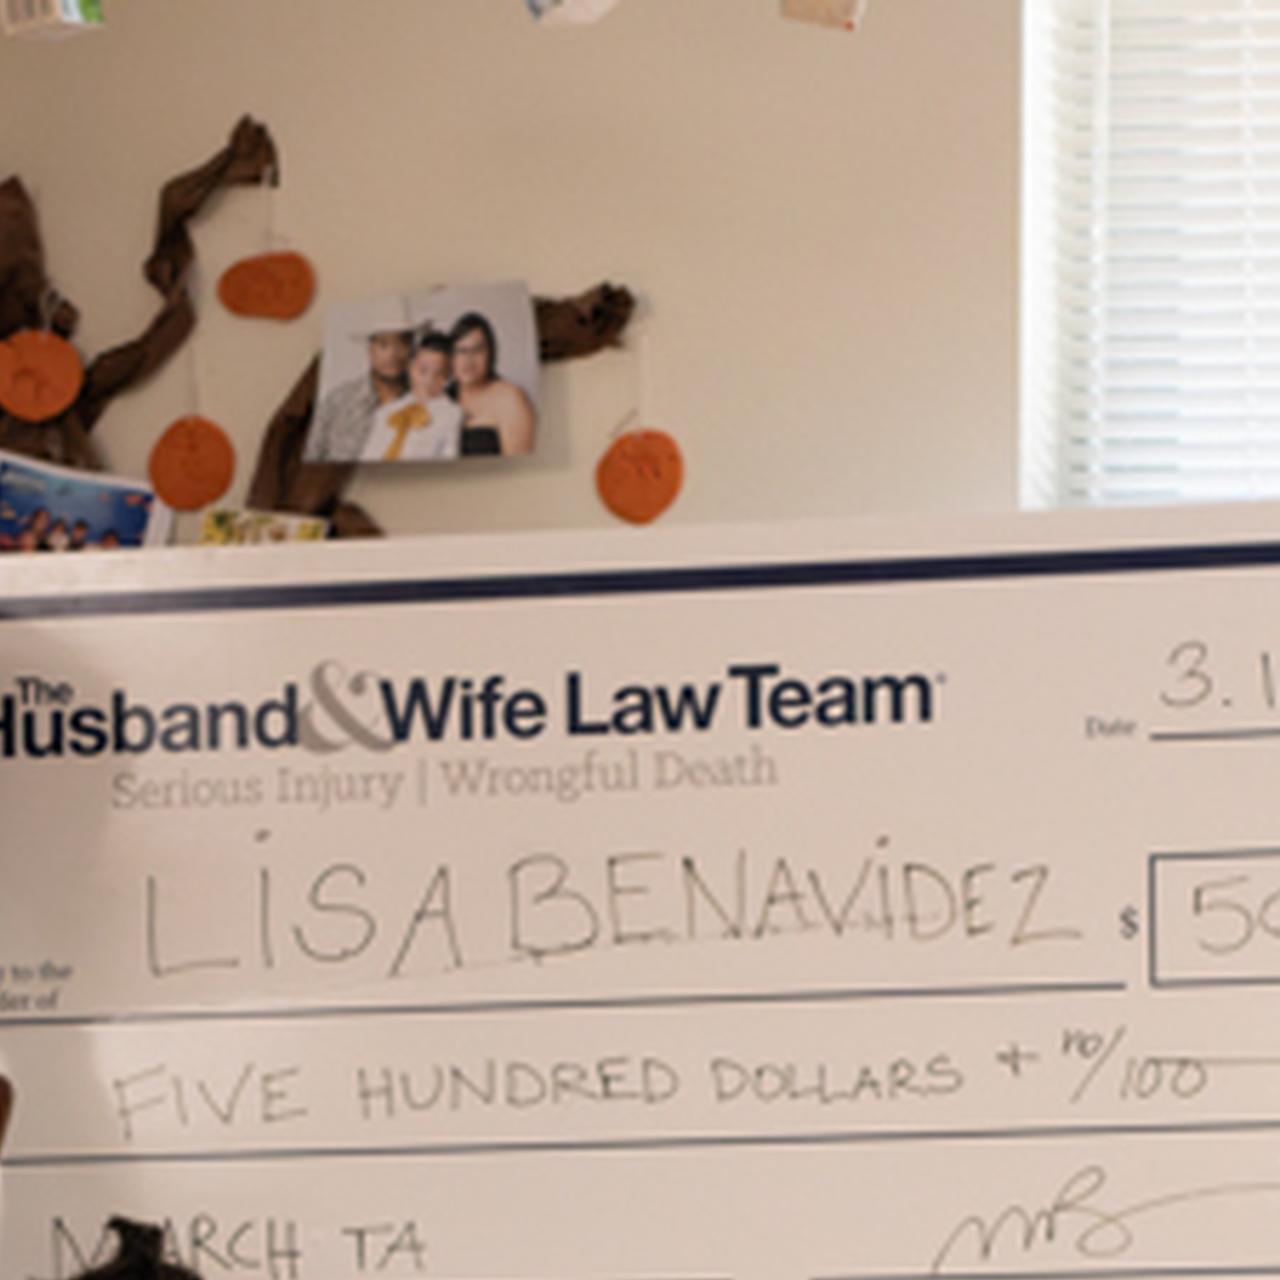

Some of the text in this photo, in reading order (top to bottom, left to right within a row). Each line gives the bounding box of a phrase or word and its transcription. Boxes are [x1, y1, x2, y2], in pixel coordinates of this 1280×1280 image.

[16, 676, 74, 705] The
[300, 659, 398, 754] &
[380, 673, 547, 742] Wife
[566, 670, 722, 737] Law
[728, 664, 933, 729] Team
[1085, 716, 1137, 739] Date
[111, 745, 779, 813] Serious Injury Wrongful Death
[1120, 904, 1140, 940] $
[112, 1062, 309, 1141] FIVE
[356, 1057, 680, 1121] HUNDRED
[709, 1054, 965, 1103] DOLLARS
[341, 1219, 427, 1273] TA
